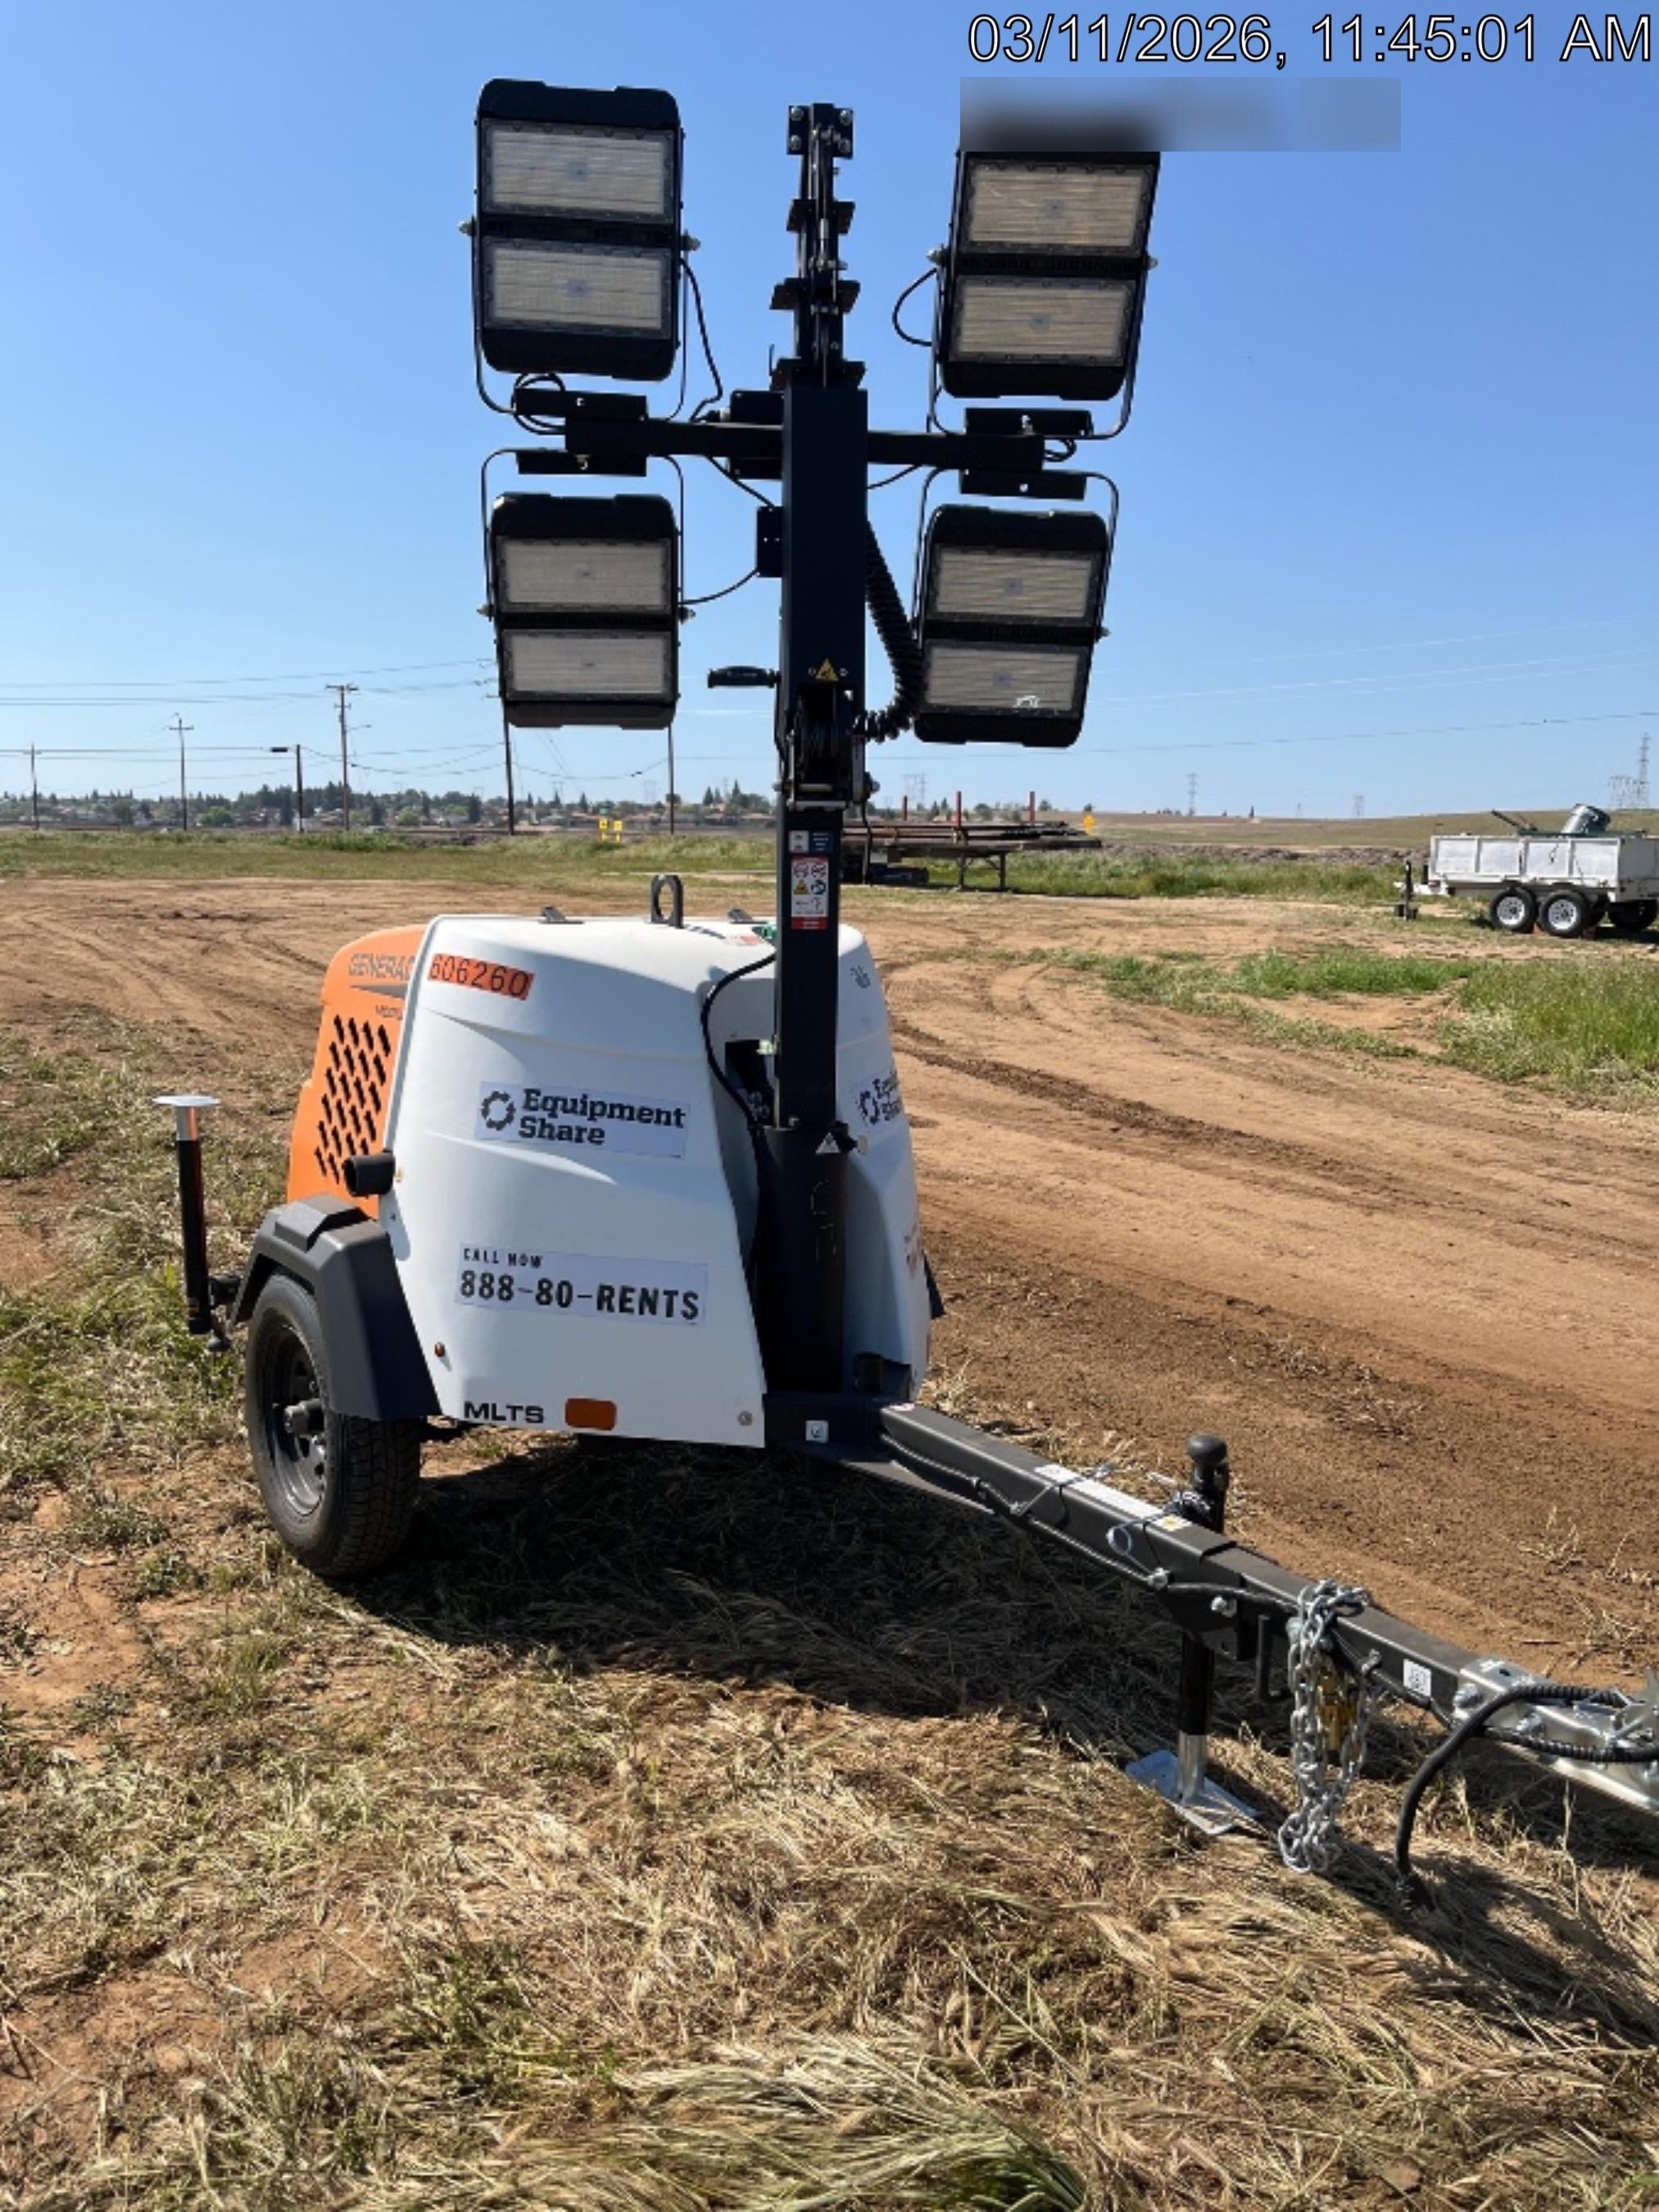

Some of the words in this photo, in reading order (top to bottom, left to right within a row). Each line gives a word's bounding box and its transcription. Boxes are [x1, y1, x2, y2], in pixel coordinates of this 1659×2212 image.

[429, 953, 529, 998] 606260
[522, 1088, 687, 1128] Equipment
[518, 1115, 605, 1145] Share
[464, 1248, 499, 1264] CALL
[508, 1253, 542, 1268] NOW
[460, 1269, 700, 1321] 888-80-RENTS
[464, 1400, 544, 1424] MLTS
